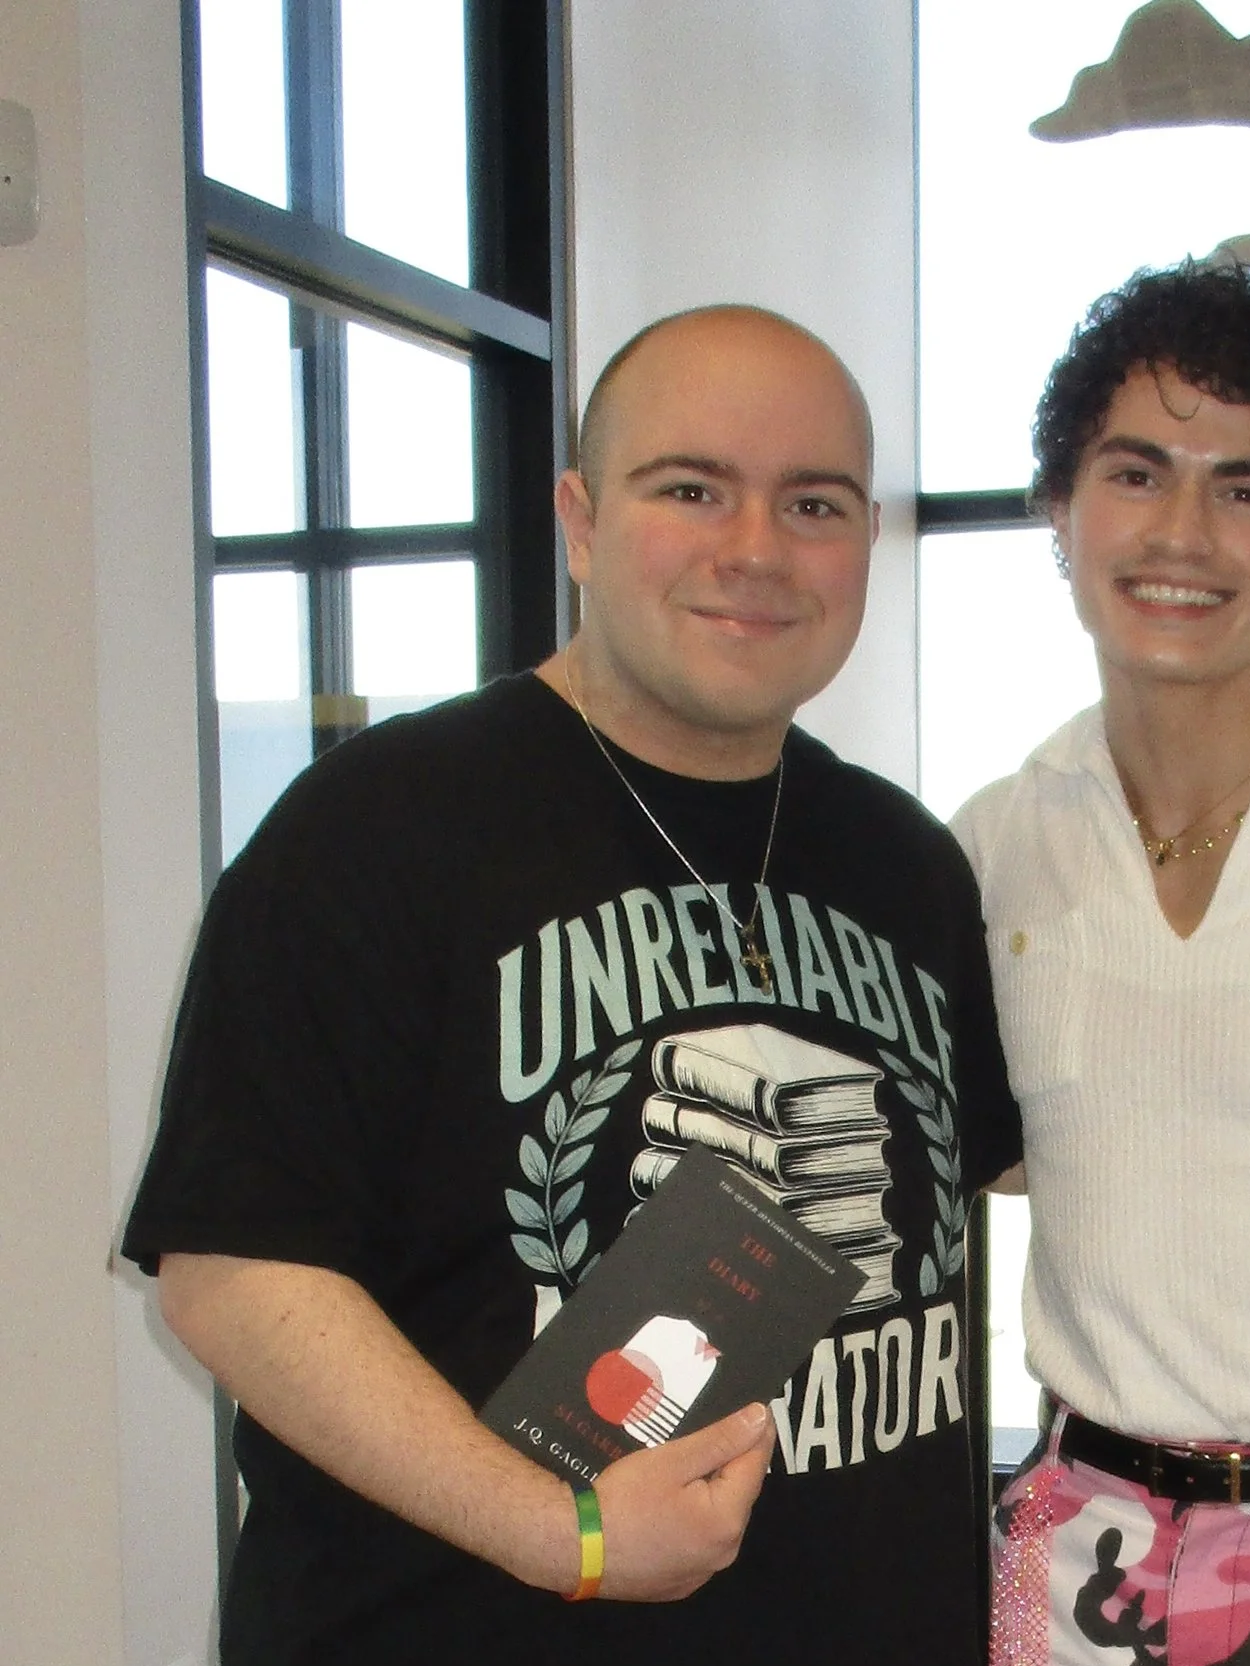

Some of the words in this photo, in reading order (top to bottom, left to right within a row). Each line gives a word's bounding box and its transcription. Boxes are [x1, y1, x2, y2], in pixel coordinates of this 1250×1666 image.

[496, 882, 958, 1106] UNRELIABLE
[739, 1231, 777, 1269] THE
[707, 1256, 763, 1303] DIARY
[513, 1417, 544, 1446] J.Q.
[549, 1442, 600, 1484] GAGLI
